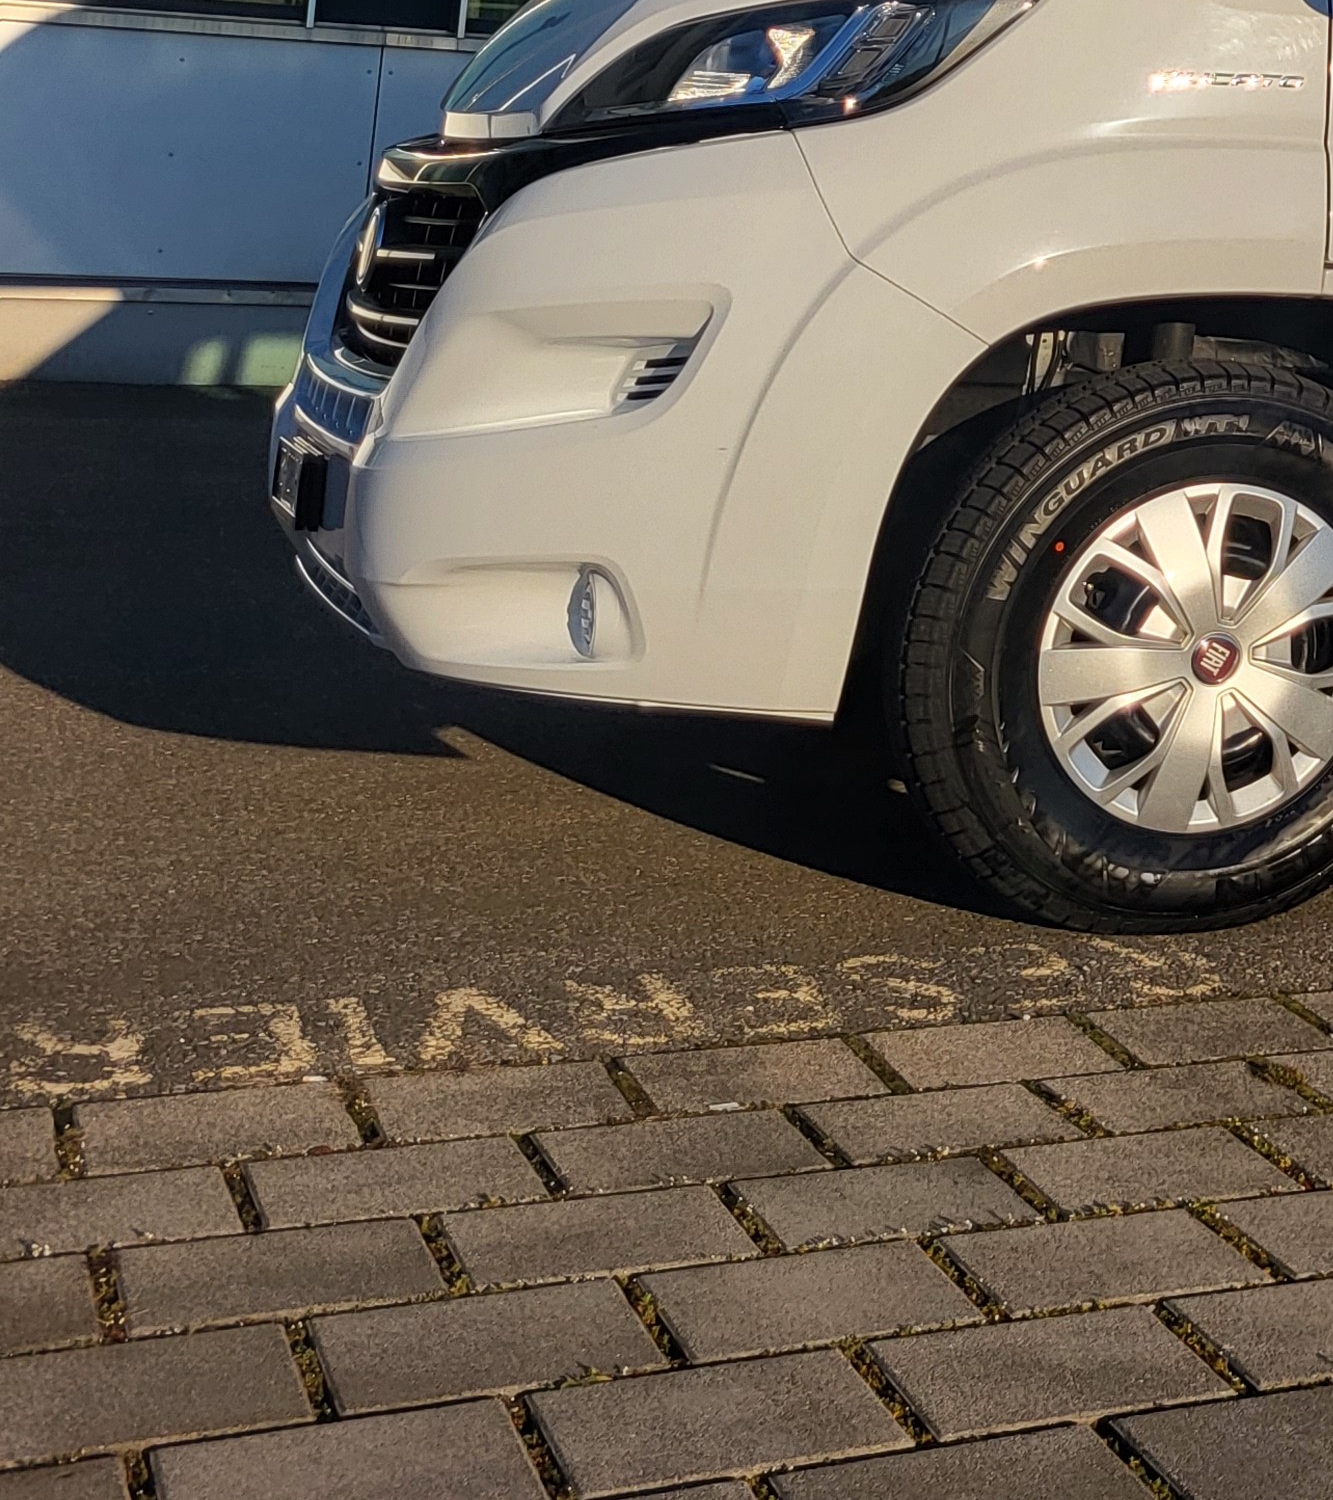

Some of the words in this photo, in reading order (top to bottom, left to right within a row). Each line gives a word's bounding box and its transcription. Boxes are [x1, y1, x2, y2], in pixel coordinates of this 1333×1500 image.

[1148, 70, 1304, 92] CATO
[986, 426, 1169, 601] WINGUARD
[1200, 642, 1231, 677] FIAT
